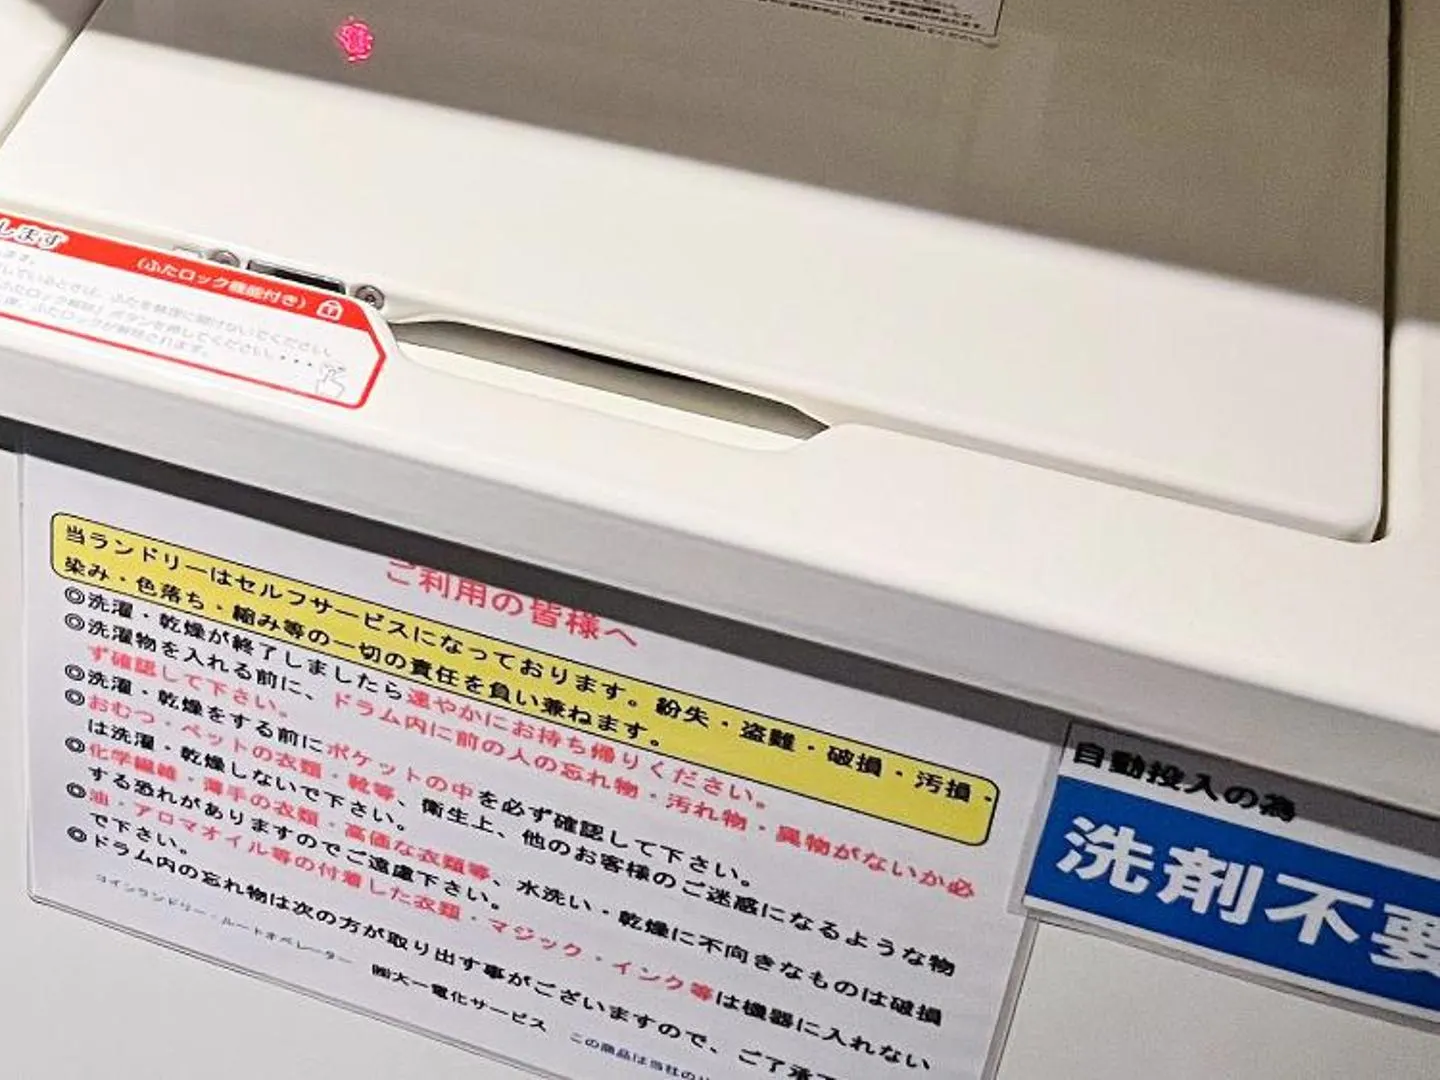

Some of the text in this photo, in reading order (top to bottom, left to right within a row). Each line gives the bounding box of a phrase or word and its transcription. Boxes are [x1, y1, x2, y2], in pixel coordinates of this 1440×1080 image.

[63, 556, 663, 748] 染み・色落ち・縮み等の一切の責任を負い兼ねます。
[386, 559, 639, 648] ご利用の皆様へ
[63, 523, 994, 805] 当ランドリーはセルフサービスになっております。紛失・盗難・破損・汚損・
[88, 644, 289, 718] ず確認して下さい。
[88, 717, 409, 833] は洗濯・乾燥しないで下さい。
[1071, 741, 1297, 823] 自動投入の為
[88, 766, 502, 911] する恐れがありますのでご遠慮下さい。
[89, 812, 189, 855] で下さい。
